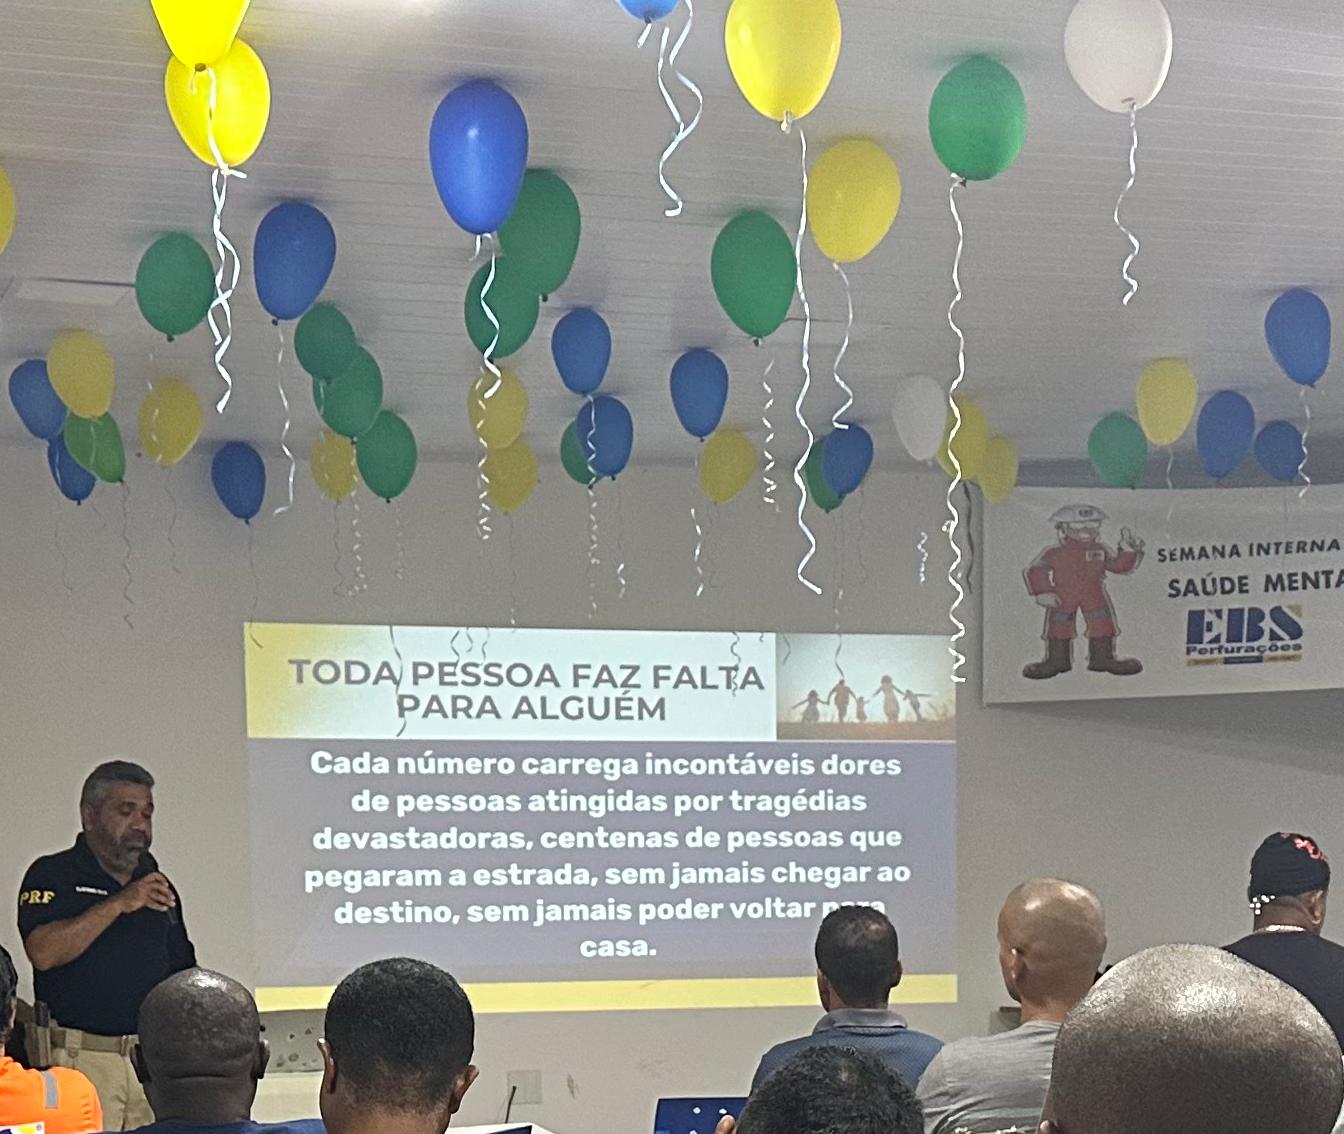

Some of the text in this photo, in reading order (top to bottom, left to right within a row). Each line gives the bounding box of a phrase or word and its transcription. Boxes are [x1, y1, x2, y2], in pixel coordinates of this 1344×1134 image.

[1157, 543, 1242, 563] SEMANA
[1248, 537, 1341, 558] INTERNA
[1167, 571, 1250, 599] SAÚDE
[1186, 605, 1304, 645] EBS
[287, 658, 766, 691] TODA PESSOA FAZ FALTA
[397, 690, 667, 721] PARA ALGUÉM
[310, 750, 902, 781] Cada número carrega incontáveis dores
[351, 788, 868, 818] de pessoas atingidas por tragédias
[312, 825, 903, 854] devastadoras, centenas de pessoas que
[304, 861, 911, 894] pegaram a estrada, sem jamais chegar ao
[20, 889, 56, 906] PRF
[334, 899, 461, 925] destino,
[466, 903, 530, 924] sem
[532, 897, 633, 927] jamais
[638, 897, 725, 926] poder
[728, 896, 817, 920] voltar
[579, 938, 657, 958] casa.
